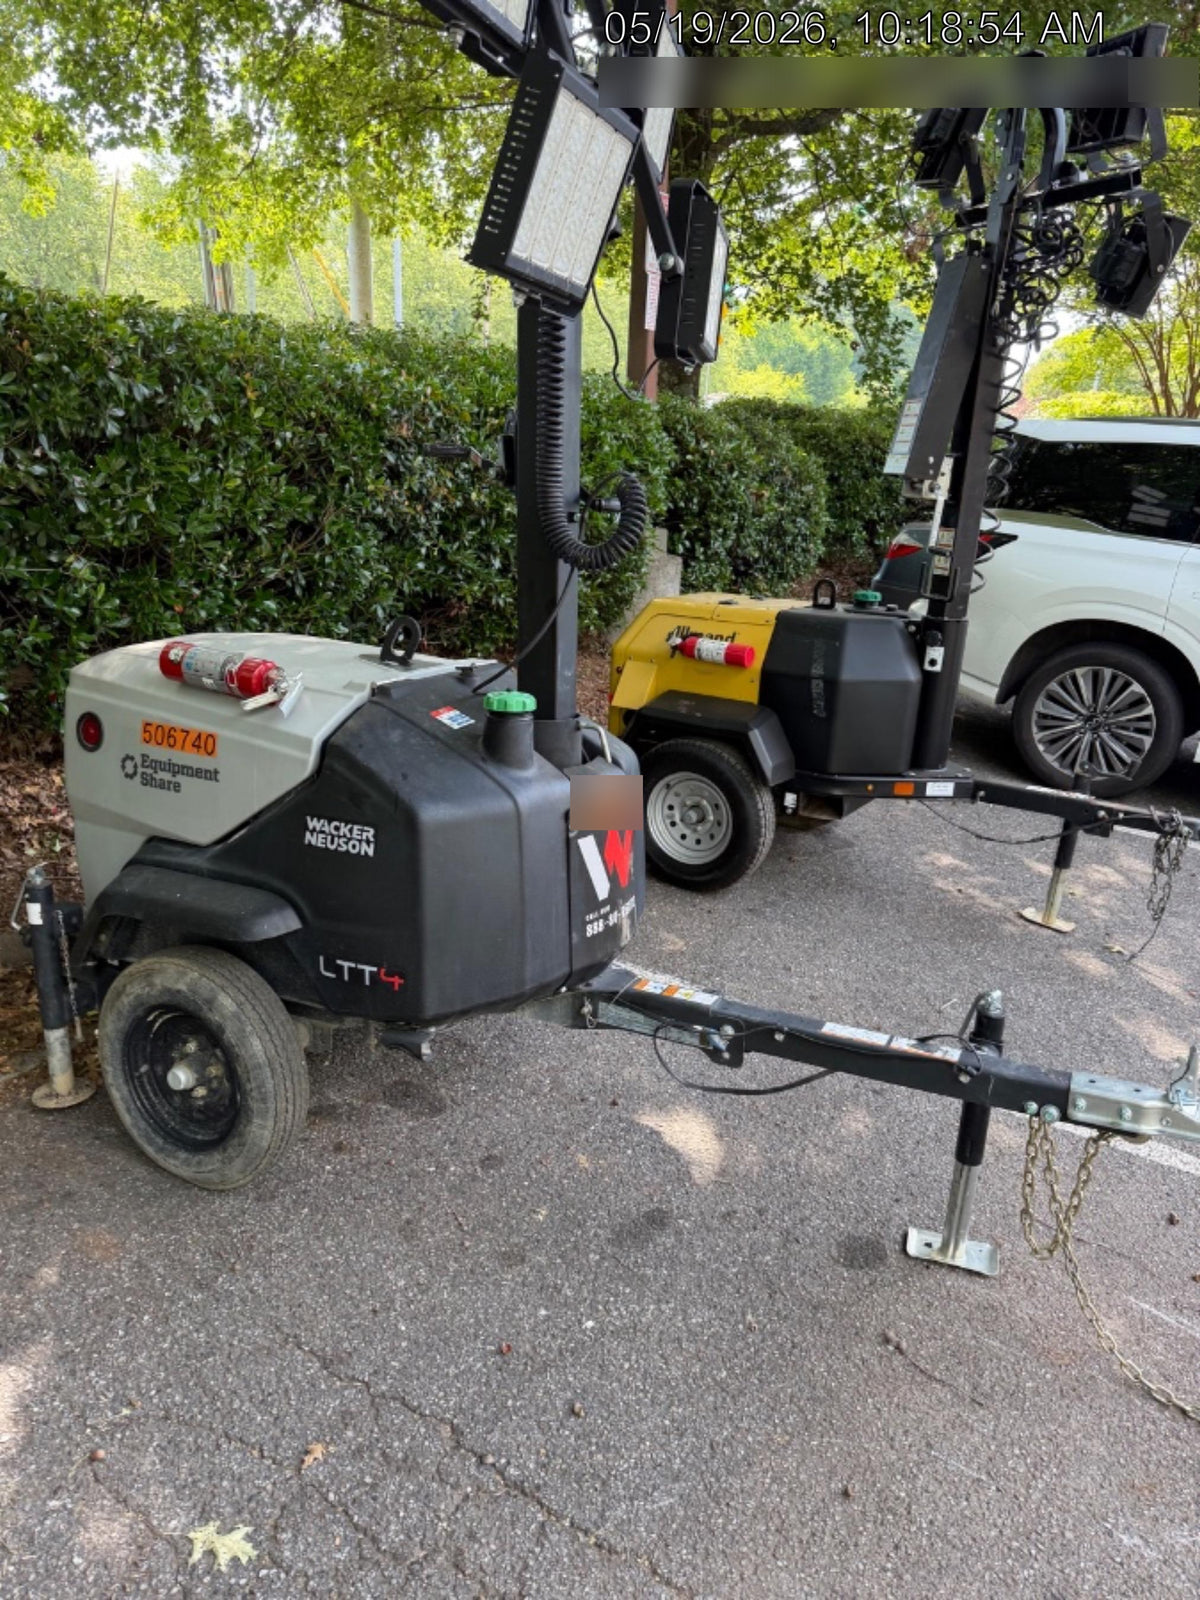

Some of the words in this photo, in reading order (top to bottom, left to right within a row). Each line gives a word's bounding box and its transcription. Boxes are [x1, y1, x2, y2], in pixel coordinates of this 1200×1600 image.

[143, 722, 216, 756] 506740
[140, 753, 220, 782] Equipment
[140, 771, 182, 793] Share
[305, 815, 375, 842] WACKER
[304, 830, 374, 857] NEUSON
[319, 954, 404, 992] LTT4
